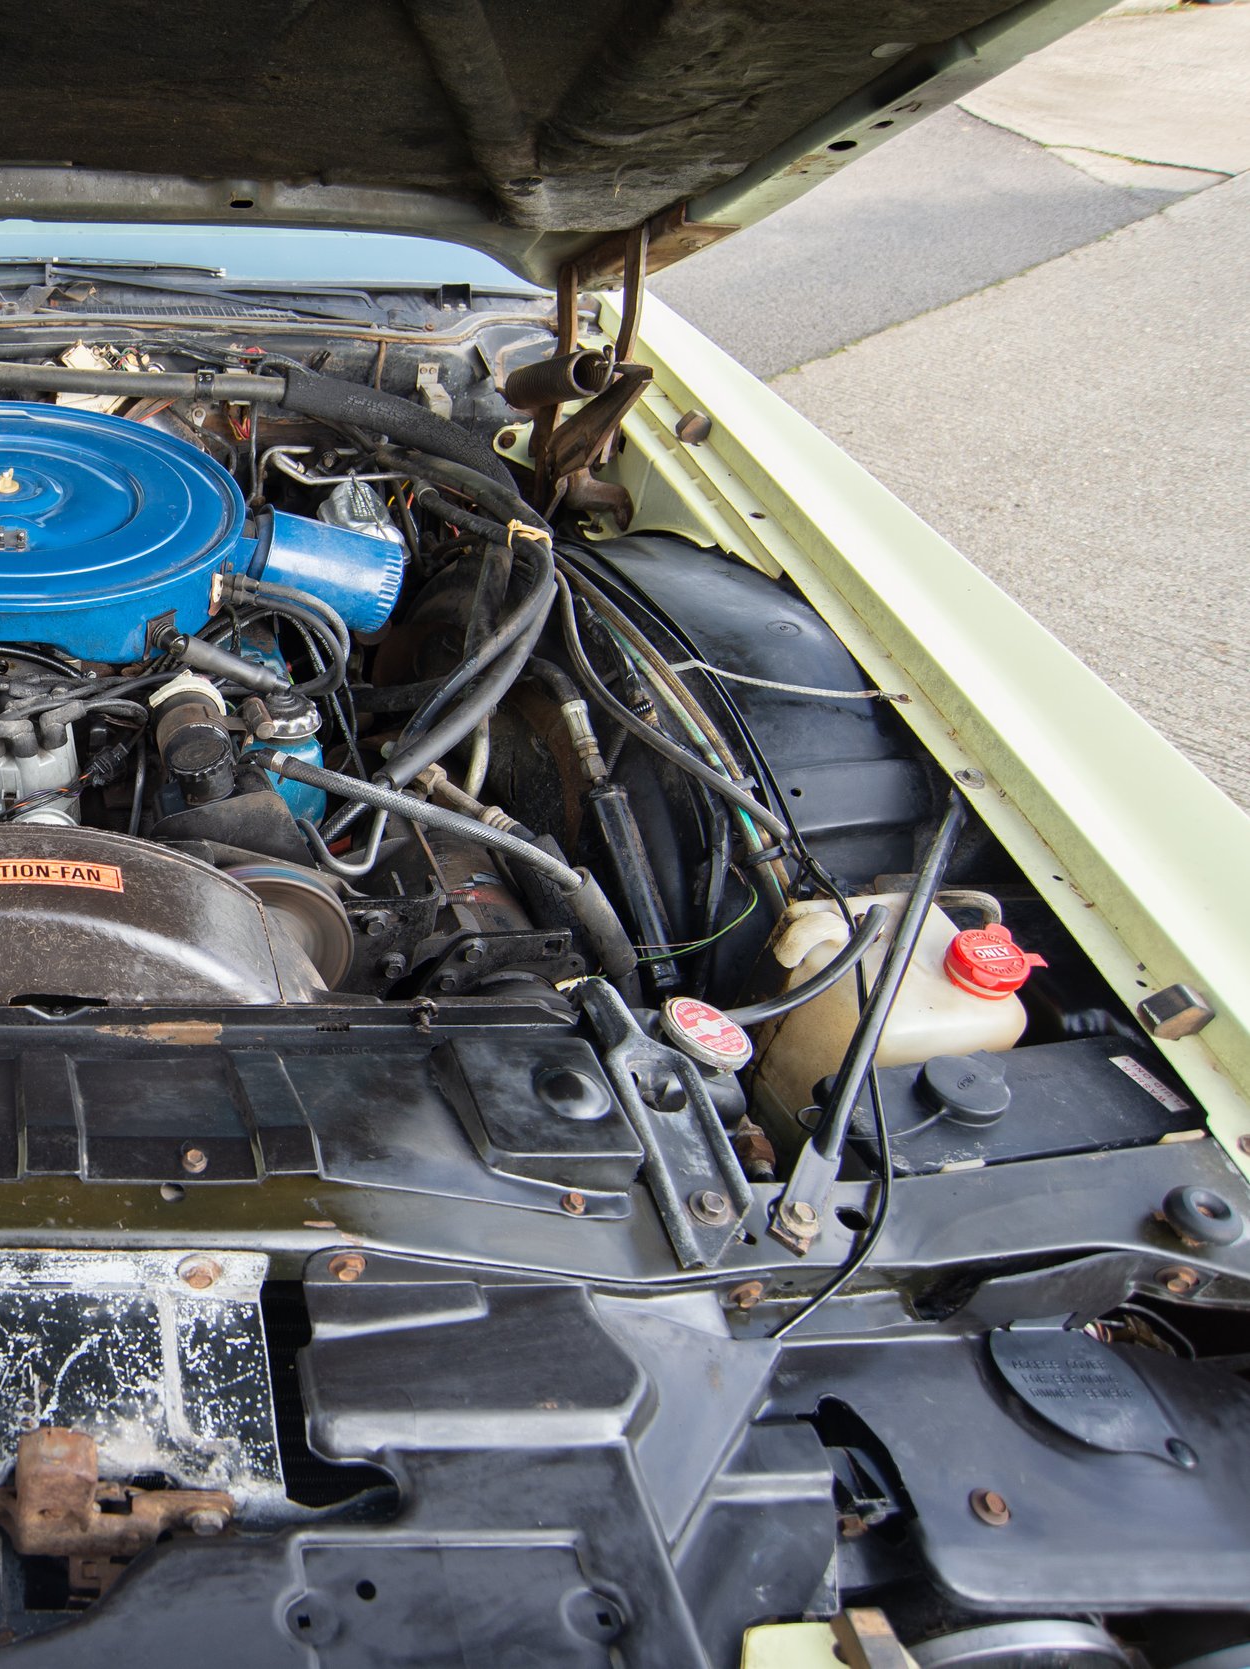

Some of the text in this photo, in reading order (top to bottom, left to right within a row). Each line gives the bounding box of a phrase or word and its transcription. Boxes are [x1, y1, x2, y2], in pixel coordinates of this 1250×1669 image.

[976, 947, 1010, 959] ONLY
[1122, 1057, 1152, 1079] ONLY
[1122, 1066, 1167, 1103] WASHER
